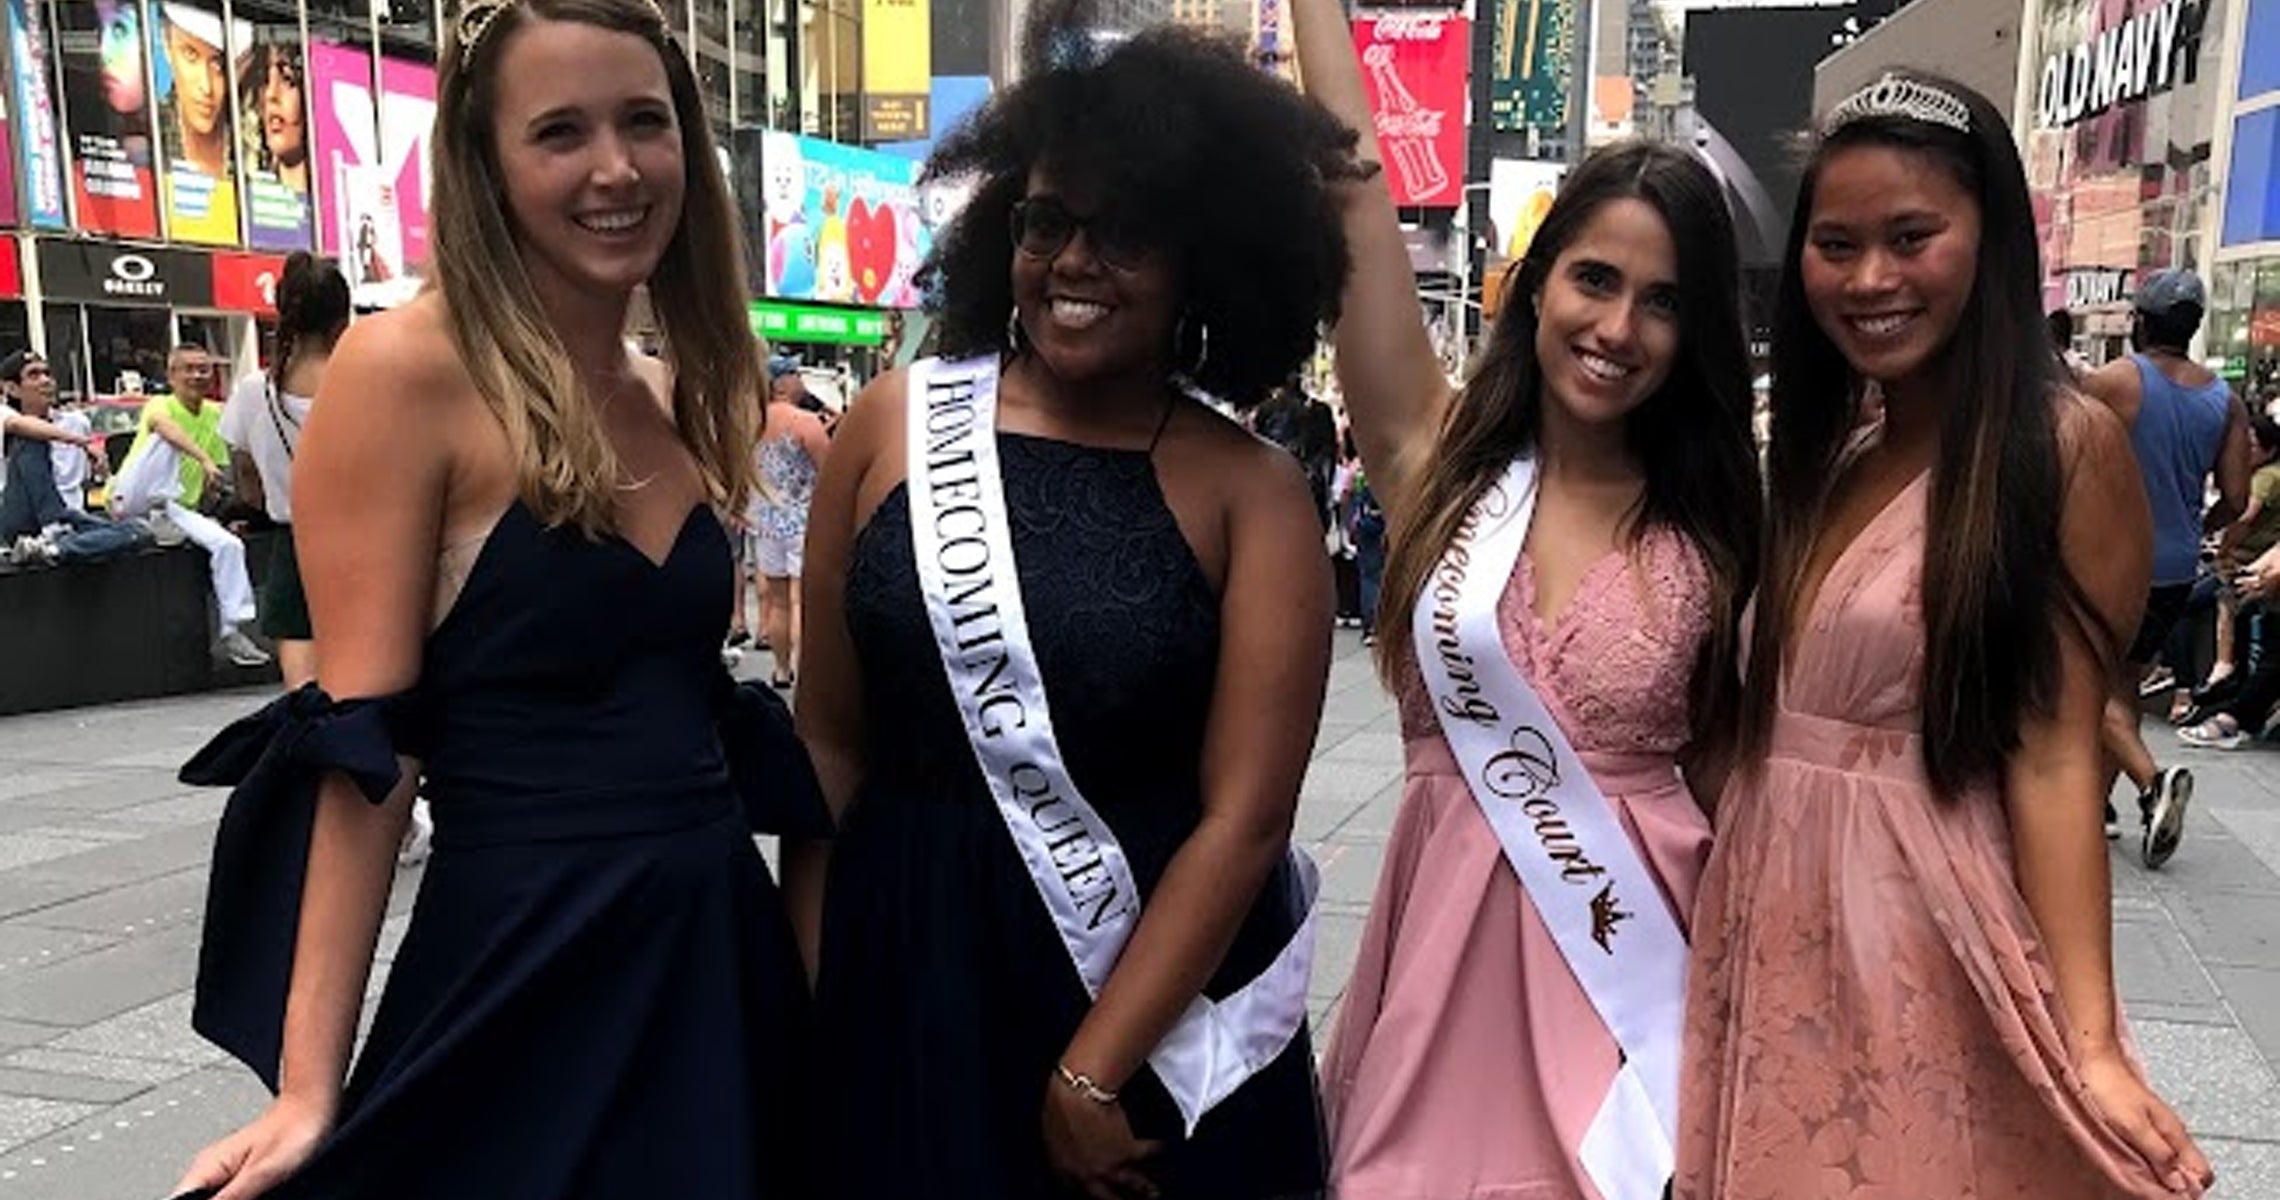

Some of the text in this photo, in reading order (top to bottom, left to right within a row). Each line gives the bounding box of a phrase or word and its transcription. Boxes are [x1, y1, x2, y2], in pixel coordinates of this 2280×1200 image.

[2040, 0, 2181, 126] OLD NAVY
[927, 379, 1131, 930] HOMECOMING QUEEN
[1433, 480, 1605, 884] mecoming Court
